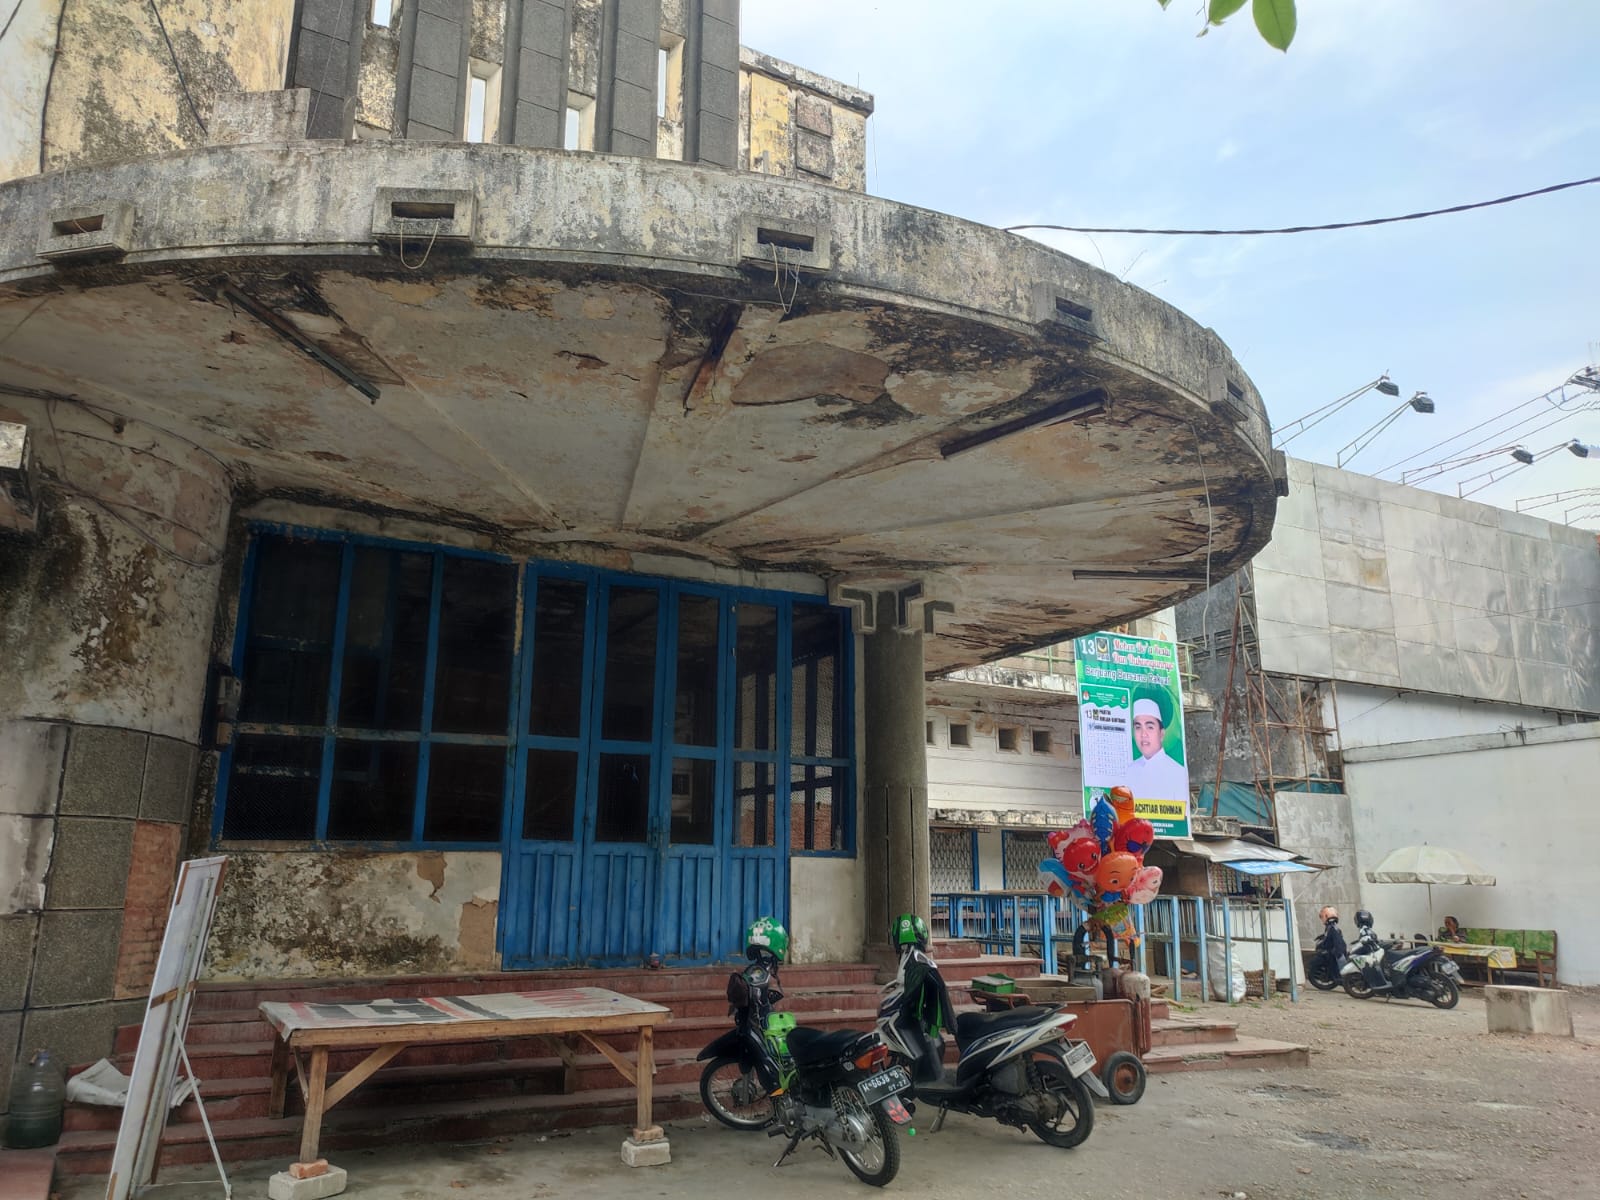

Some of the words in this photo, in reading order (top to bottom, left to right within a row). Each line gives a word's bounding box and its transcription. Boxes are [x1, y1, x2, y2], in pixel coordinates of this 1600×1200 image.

[1081, 639, 1096, 655] 13
[1085, 665, 1116, 681] Berjuang
[1116, 669, 1147, 681] Bersama
[1135, 803, 1158, 814] ACHTIAR
